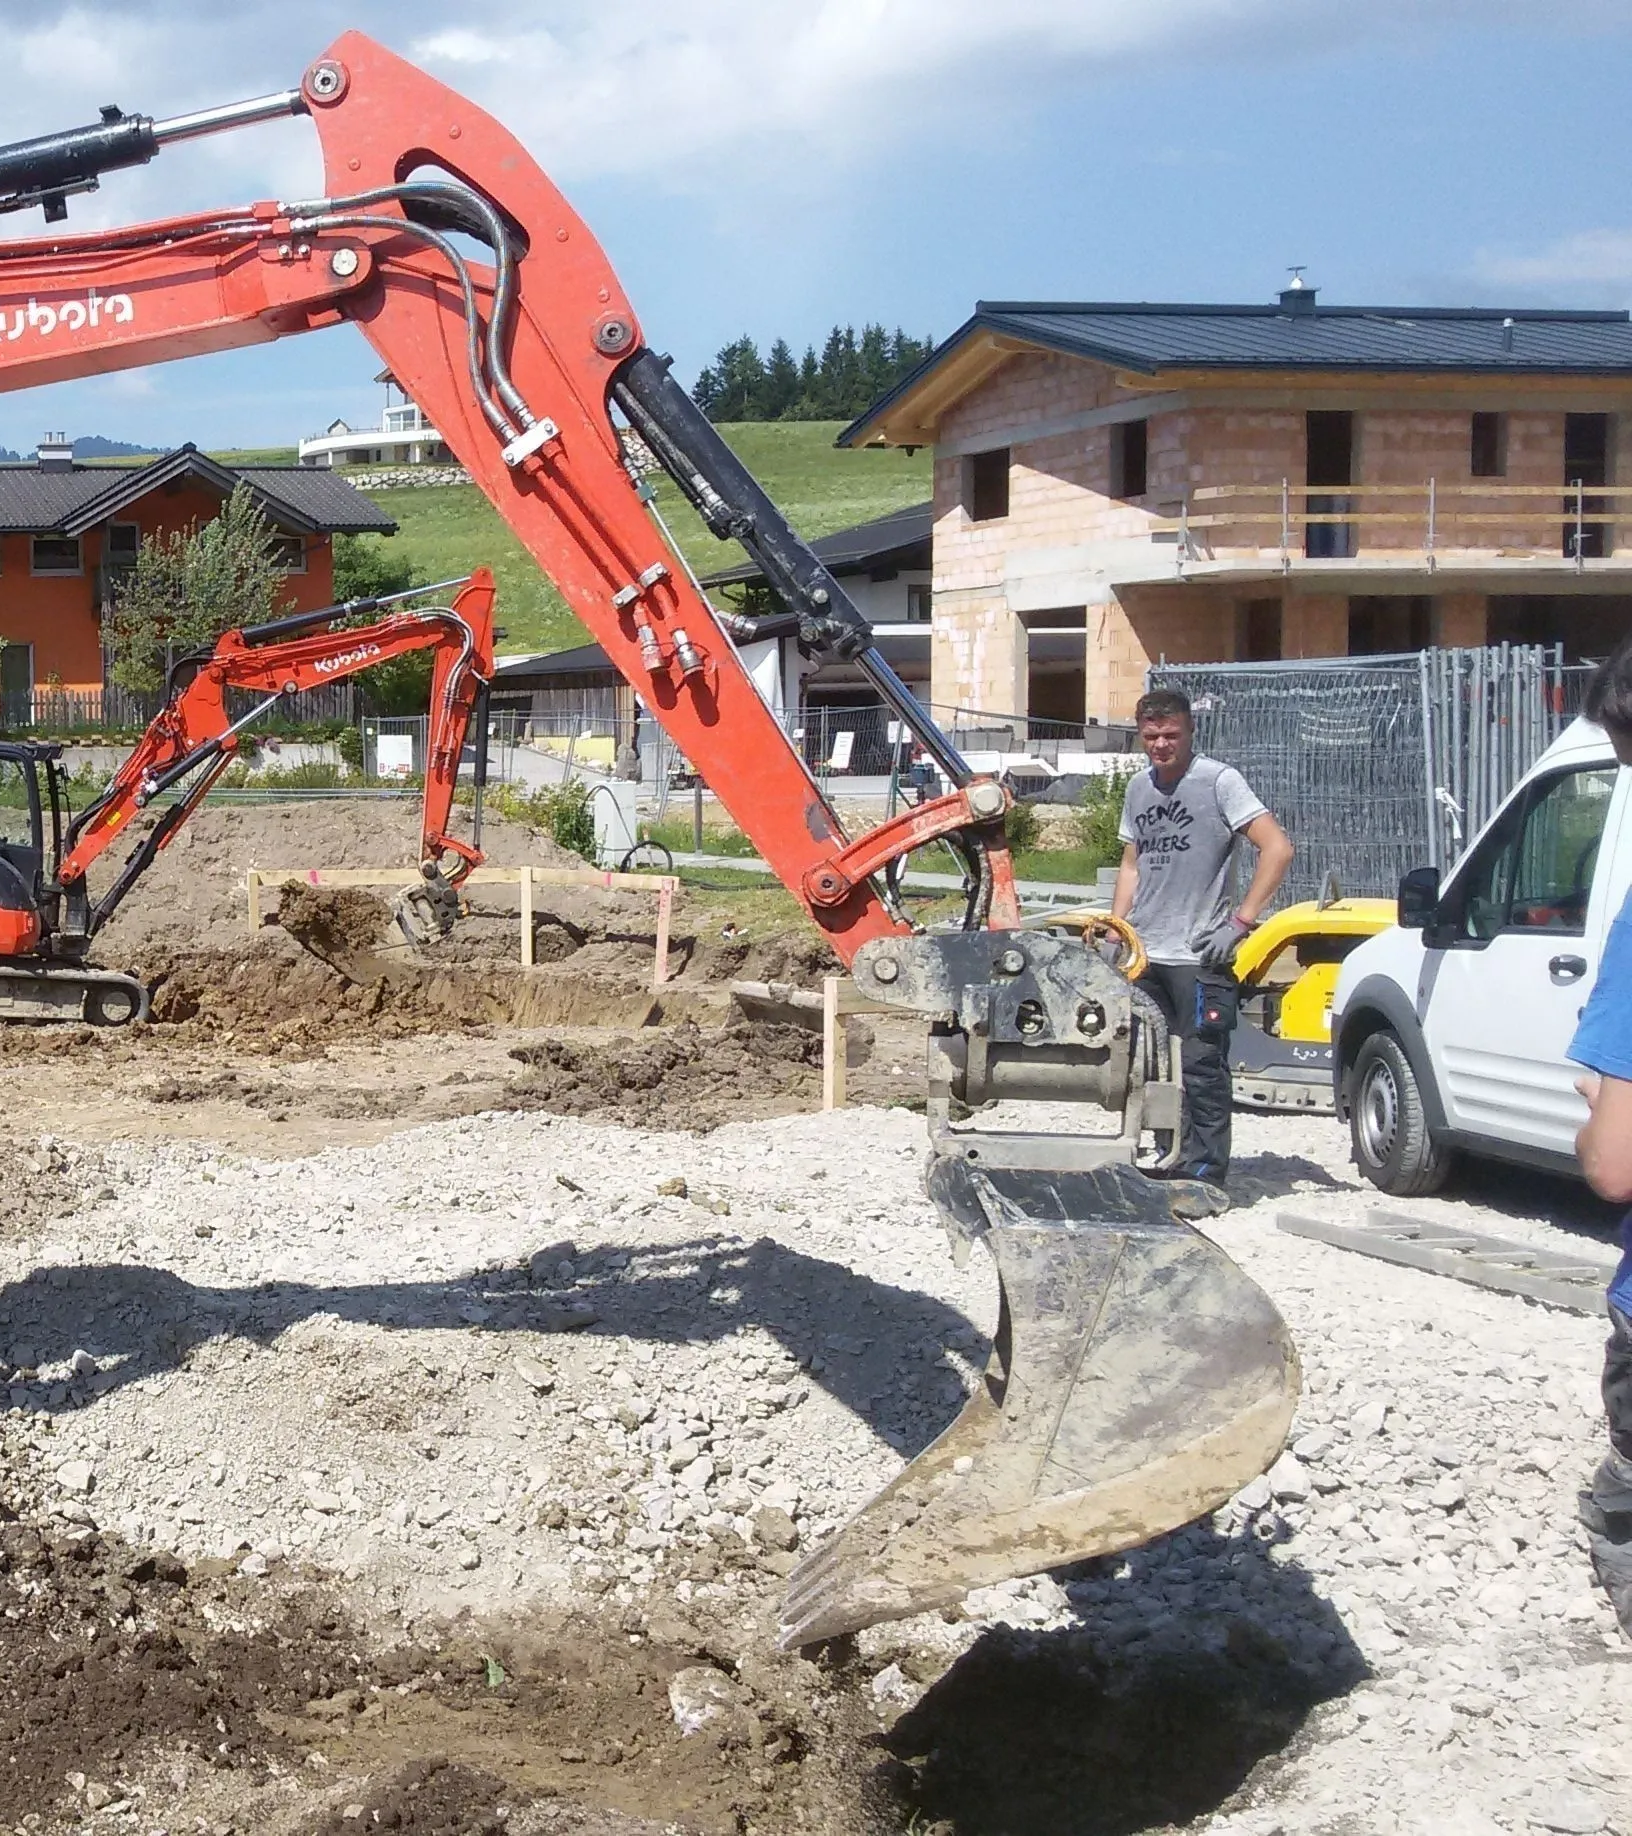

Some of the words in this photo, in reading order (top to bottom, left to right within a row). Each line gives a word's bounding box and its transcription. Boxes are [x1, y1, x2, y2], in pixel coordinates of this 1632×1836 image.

[314, 643, 382, 673] Kubota
[1135, 800, 1194, 831] DENIM
[1136, 834, 1191, 860] MAKERS
